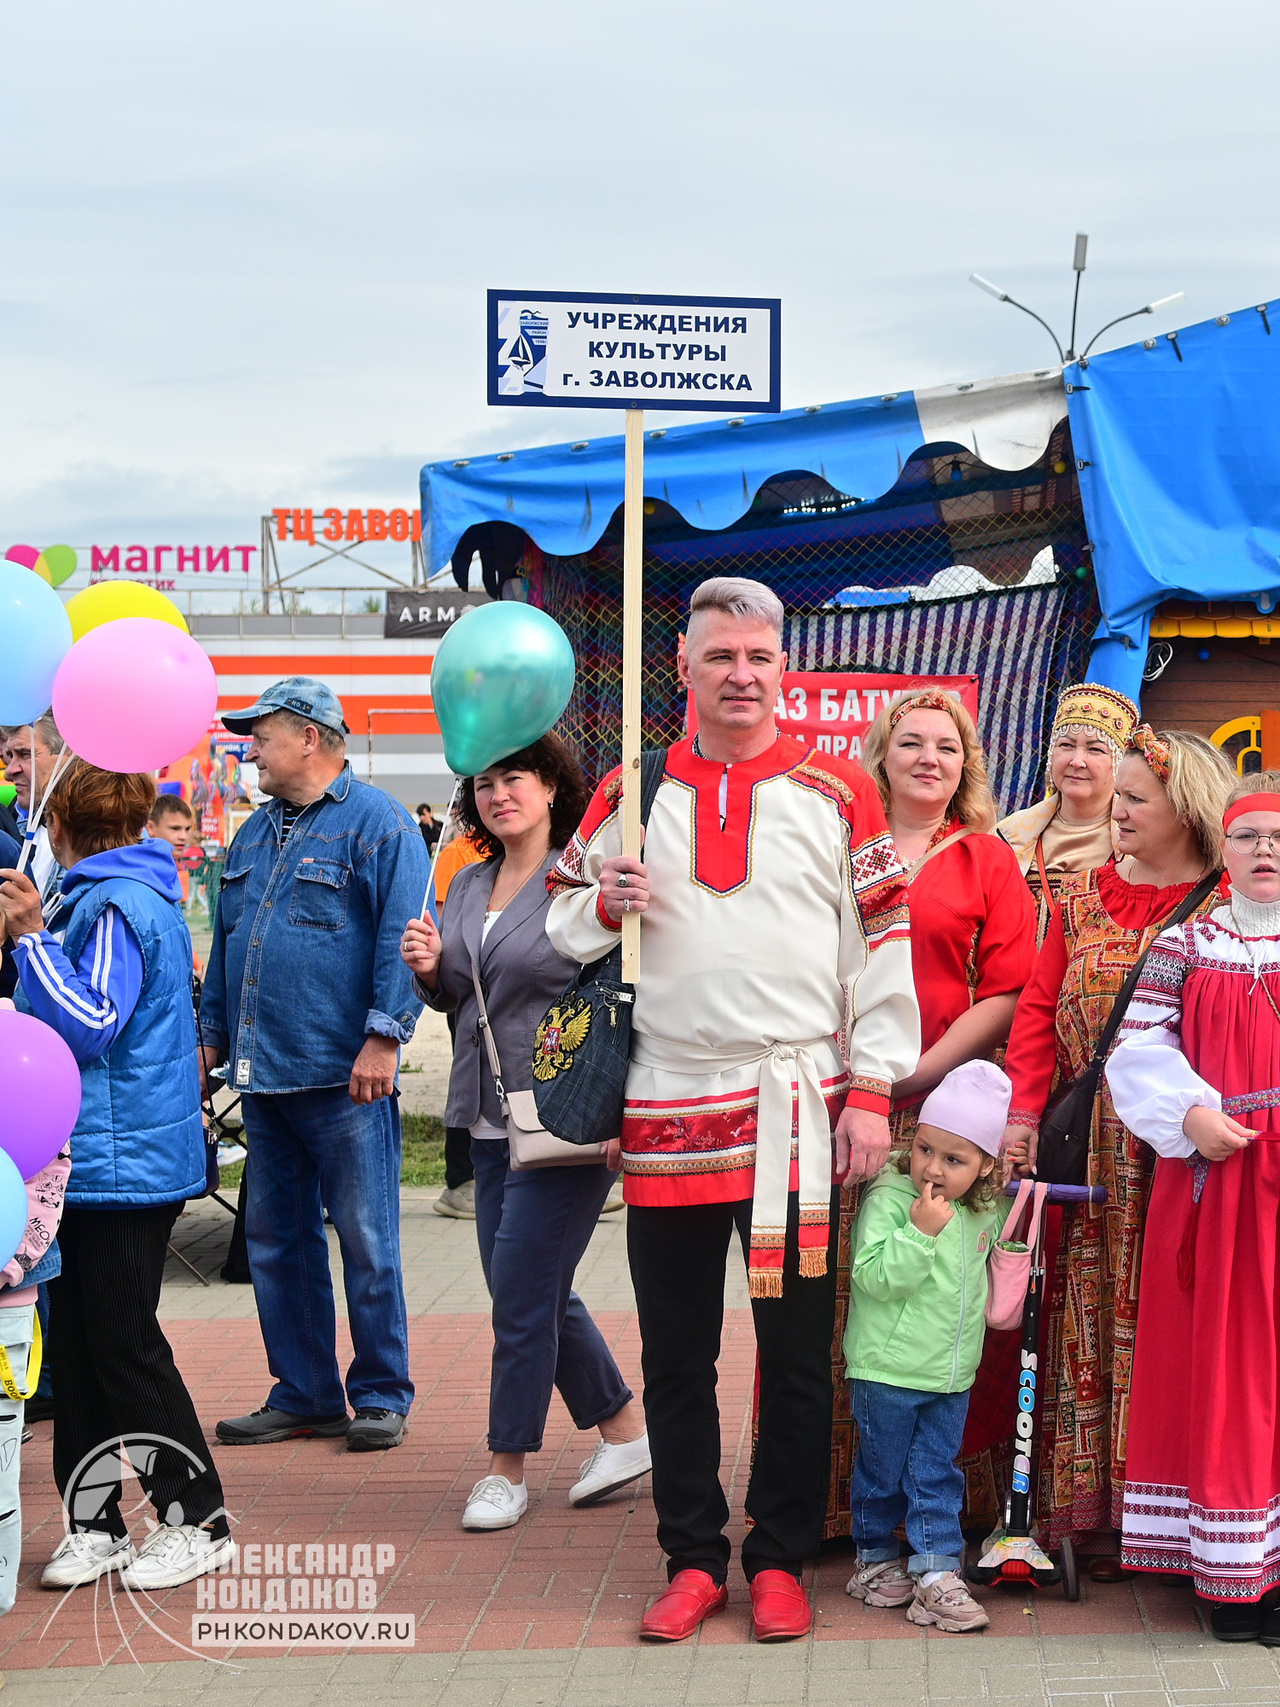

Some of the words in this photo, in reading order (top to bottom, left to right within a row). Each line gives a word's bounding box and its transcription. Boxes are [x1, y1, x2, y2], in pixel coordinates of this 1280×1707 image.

[566, 311, 748, 335] УЧРЕЖДЕНИЯ
[588, 341, 727, 362] КУЛЬТУРЫ
[562, 373, 580, 386] г.
[589, 370, 753, 391] ЗАВОЛЖСКА
[272, 508, 315, 546] ТЦ
[772, 687, 807, 720] АЗ
[816, 735, 865, 760] ПРА
[1011, 1348, 1038, 1495] SCOOTER
